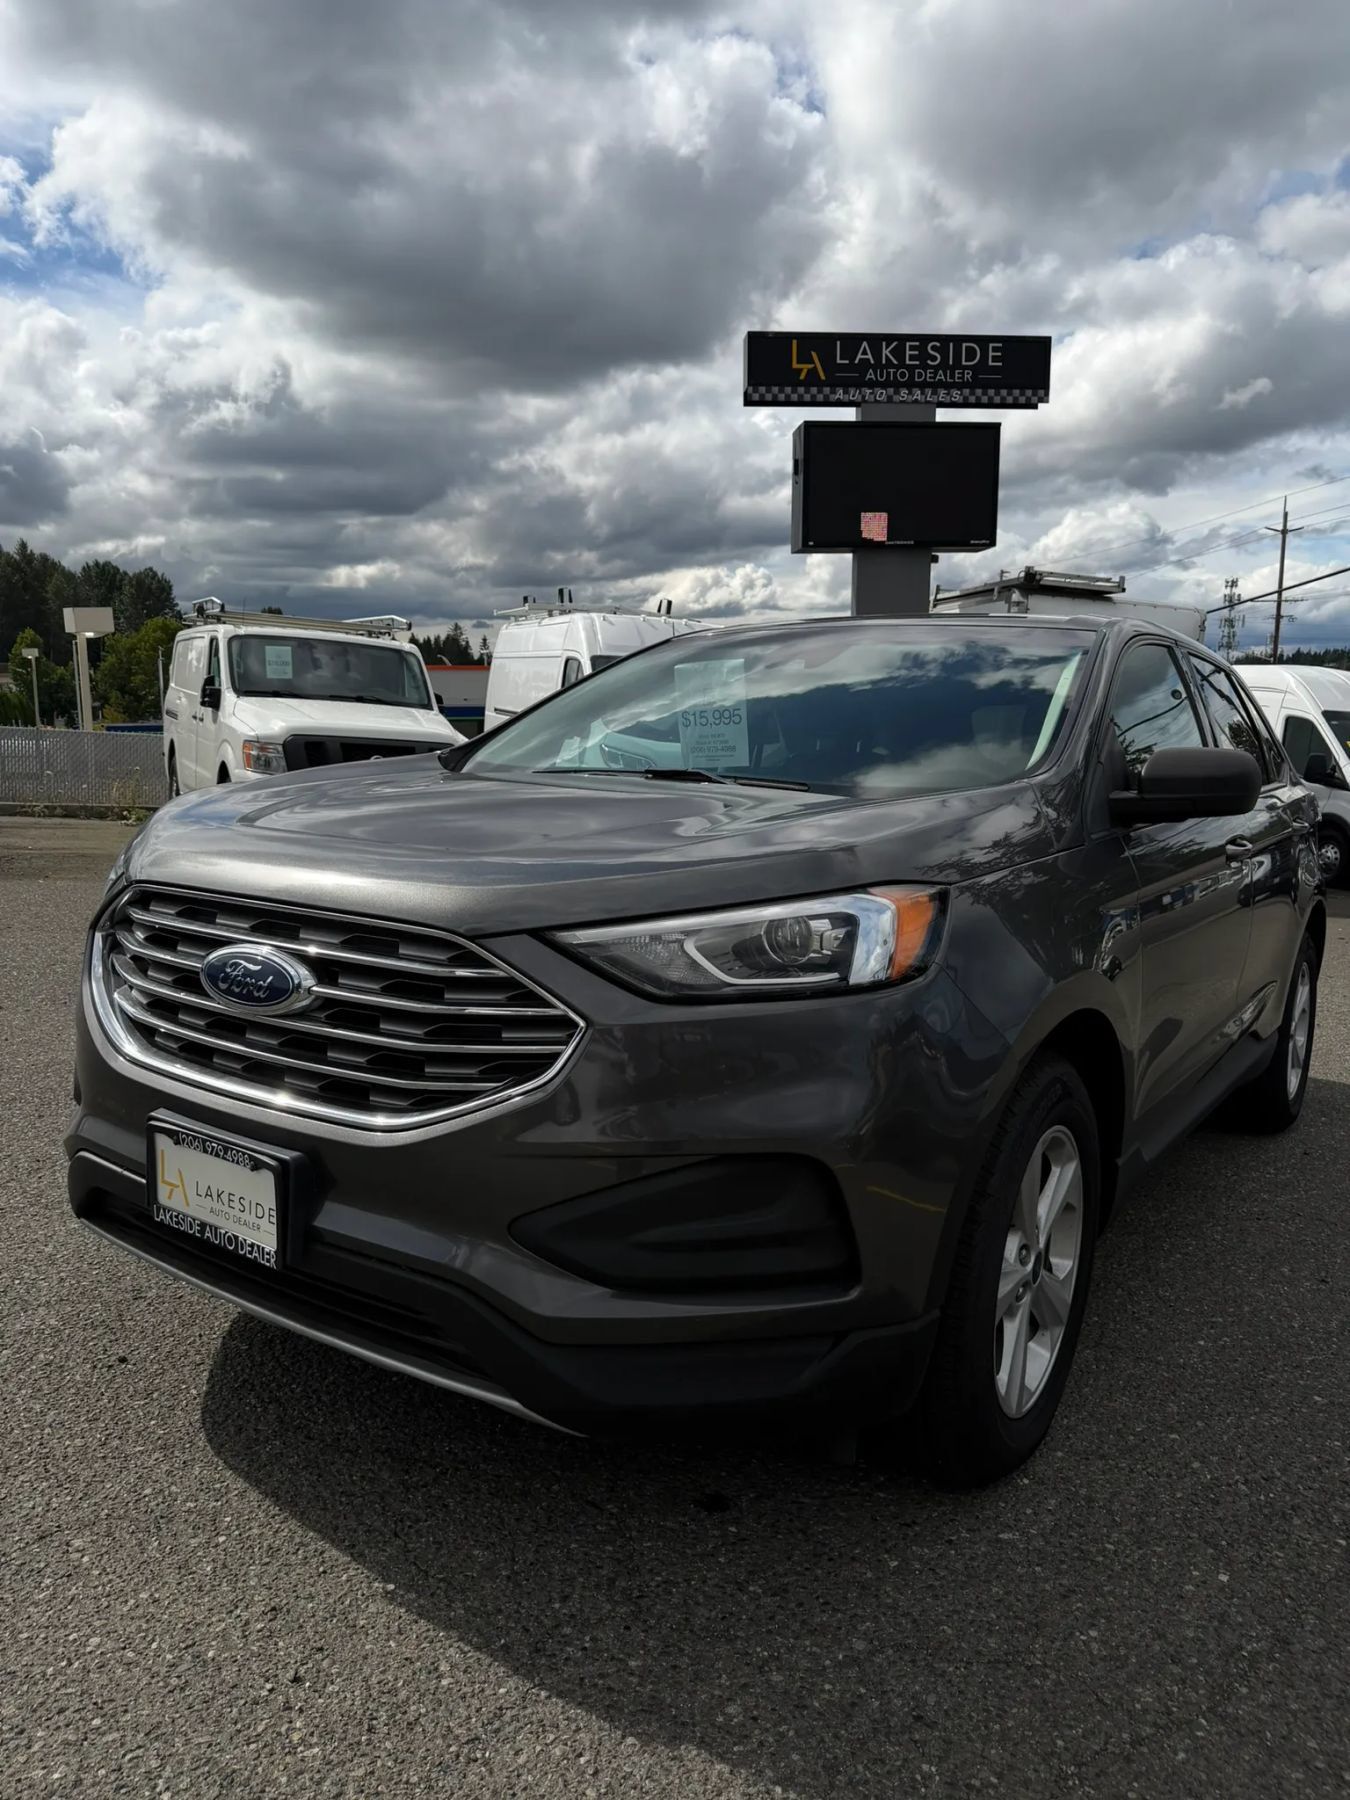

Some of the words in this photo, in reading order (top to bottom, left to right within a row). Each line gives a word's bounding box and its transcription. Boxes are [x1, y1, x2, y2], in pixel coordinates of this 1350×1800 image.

[836, 341, 1003, 366] LAKESIDE
[865, 368, 909, 382] AUTO
[914, 369, 973, 383] DEALER
[834, 390, 887, 400] AUTO
[900, 391, 962, 401] SALES
[681, 708, 743, 728] $15,995
[218, 960, 273, 998] Ford
[178, 1132, 203, 1152] (206)
[205, 1142, 250, 1168] 979-4988
[195, 1181, 276, 1225] LAKESIDE
[209, 1206, 230, 1221] AUTO
[232, 1216, 261, 1233] DEALER
[153, 1204, 201, 1237] LAKESIDE
[204, 1225, 235, 1250] AUTO
[238, 1237, 277, 1270] DEALER
